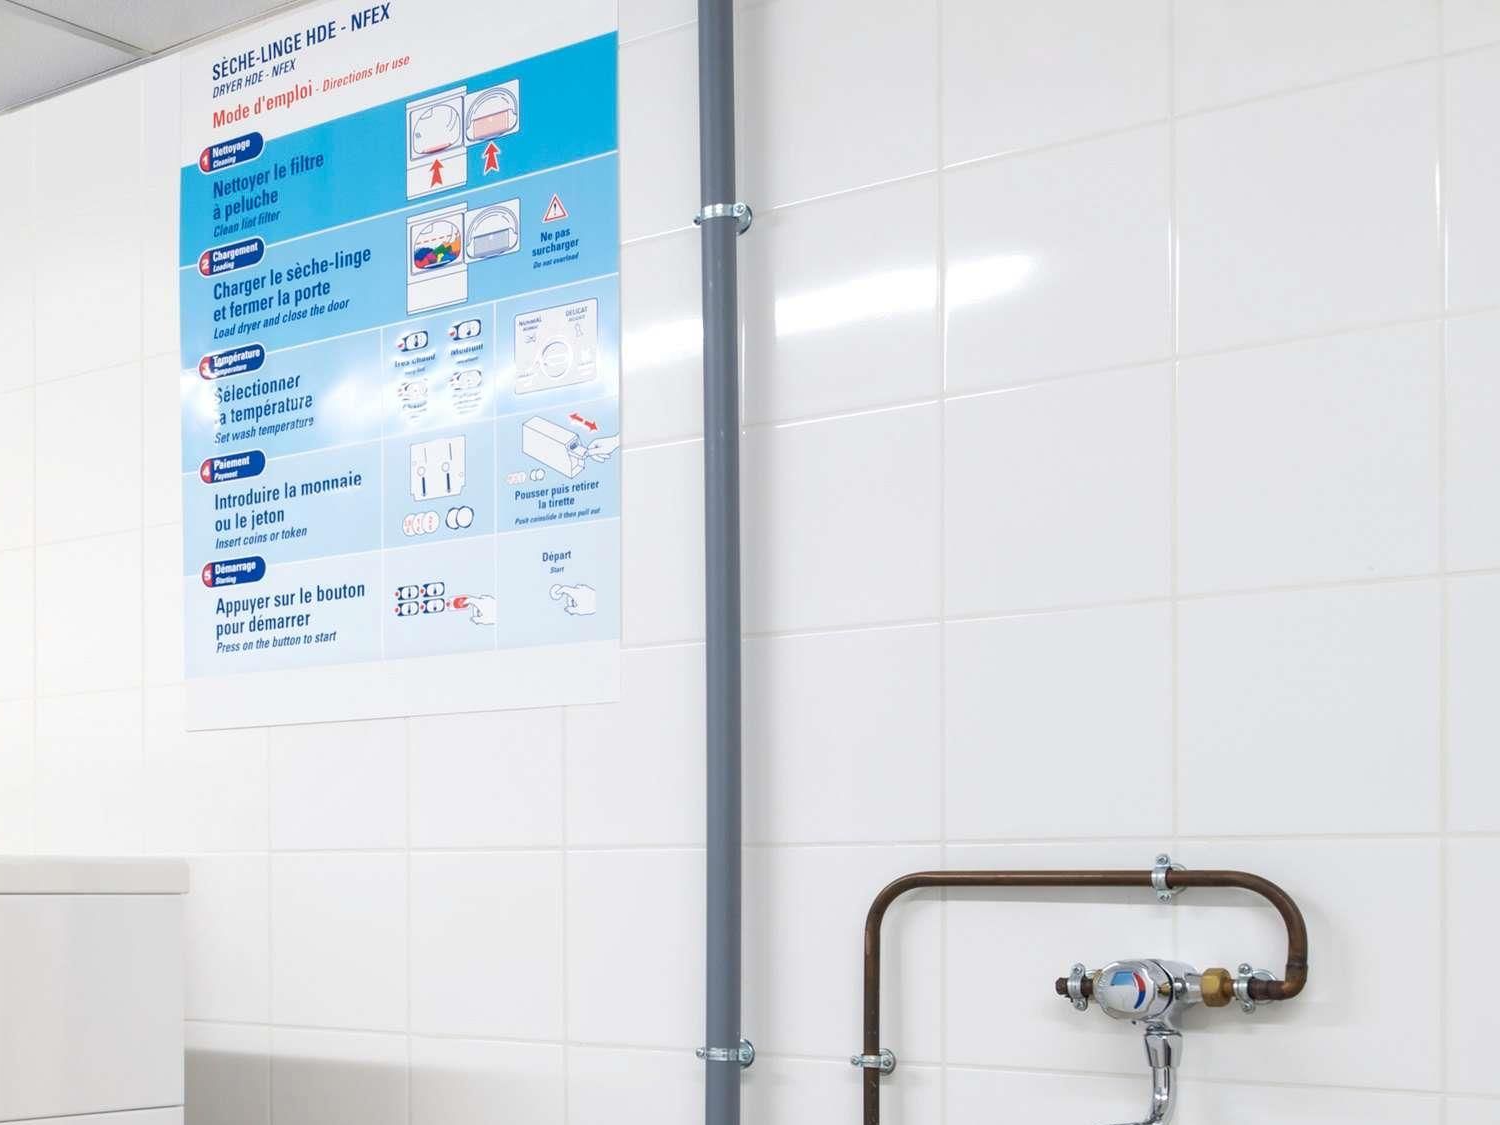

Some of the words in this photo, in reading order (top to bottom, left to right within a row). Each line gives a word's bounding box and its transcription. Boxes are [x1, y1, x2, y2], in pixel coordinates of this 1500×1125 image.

[212, 33, 302, 80] SÈCHE-LINGE
[307, 21, 336, 47] HDE
[351, 3, 391, 31] NFEX
[213, 77, 242, 98] DRYER
[245, 70, 263, 86] HDE
[272, 59, 296, 78] NFEX
[213, 104, 249, 128] Mode
[254, 80, 312, 115] d'emploi
[323, 69, 372, 92] Directions
[376, 62, 389, 74] for
[392, 55, 410, 68] use
[213, 139, 250, 157] Nettoyage
[203, 155, 207, 165] 1
[213, 156, 236, 168] Cleaning
[213, 170, 269, 198] Nettoyer
[274, 163, 286, 180] le
[290, 153, 324, 176] filtre
[213, 204, 220, 220] à
[225, 190, 278, 221] peluche
[213, 223, 239, 237] Clean
[241, 217, 256, 230] lint
[258, 211, 281, 225] filter
[541, 231, 553, 242] Ne
[555, 228, 570, 241] pas
[213, 242, 258, 262] Chargement
[532, 238, 579, 257] surcharger
[202, 260, 208, 269] 2
[213, 261, 235, 272] Loading
[214, 275, 266, 300] Charger
[270, 269, 282, 286] le
[287, 249, 371, 281] sèche-linge
[214, 305, 226, 322] et
[230, 294, 274, 318] fermer
[278, 290, 290, 305] la
[295, 282, 330, 307] porte
[214, 325, 235, 339] Load
[238, 320, 261, 334] dryer
[263, 313, 280, 327] and
[282, 308, 307, 323] close
[310, 303, 325, 316] the
[328, 299, 349, 312] door
[213, 349, 260, 367] Température
[215, 375, 300, 404] Sélectionner
[231, 395, 312, 423] température
[215, 432, 230, 444] Set
[232, 427, 256, 441] wash
[258, 417, 314, 436] temperature
[203, 467, 209, 476] 4
[214, 456, 250, 470] Paiement
[215, 487, 280, 510] Introduire
[285, 482, 297, 499] la
[301, 471, 362, 496] monnaie
[515, 489, 549, 500] Pousser
[551, 484, 569, 496] puis
[572, 481, 599, 492] retirer
[539, 500, 546, 509] la
[549, 497, 574, 507] tirette
[215, 518, 230, 532] ou
[235, 513, 247, 529] le
[251, 510, 284, 530] jeton
[216, 537, 241, 549] Insert
[243, 532, 267, 545] coins
[270, 531, 279, 541] or
[281, 526, 307, 539] token
[215, 561, 256, 575] Démarrage
[543, 551, 571, 563] Départ
[204, 571, 211, 581] 5
[216, 596, 270, 617] Appuyer
[274, 592, 295, 607] sur
[300, 588, 312, 604] le
[317, 584, 365, 602] bouton
[216, 621, 245, 640] pour
[249, 613, 310, 632] démarrer
[216, 642, 240, 653] Press
[242, 641, 253, 650] on
[256, 638, 269, 649] the
[272, 634, 301, 647] button
[303, 633, 312, 643] to
[315, 631, 337, 642] start
